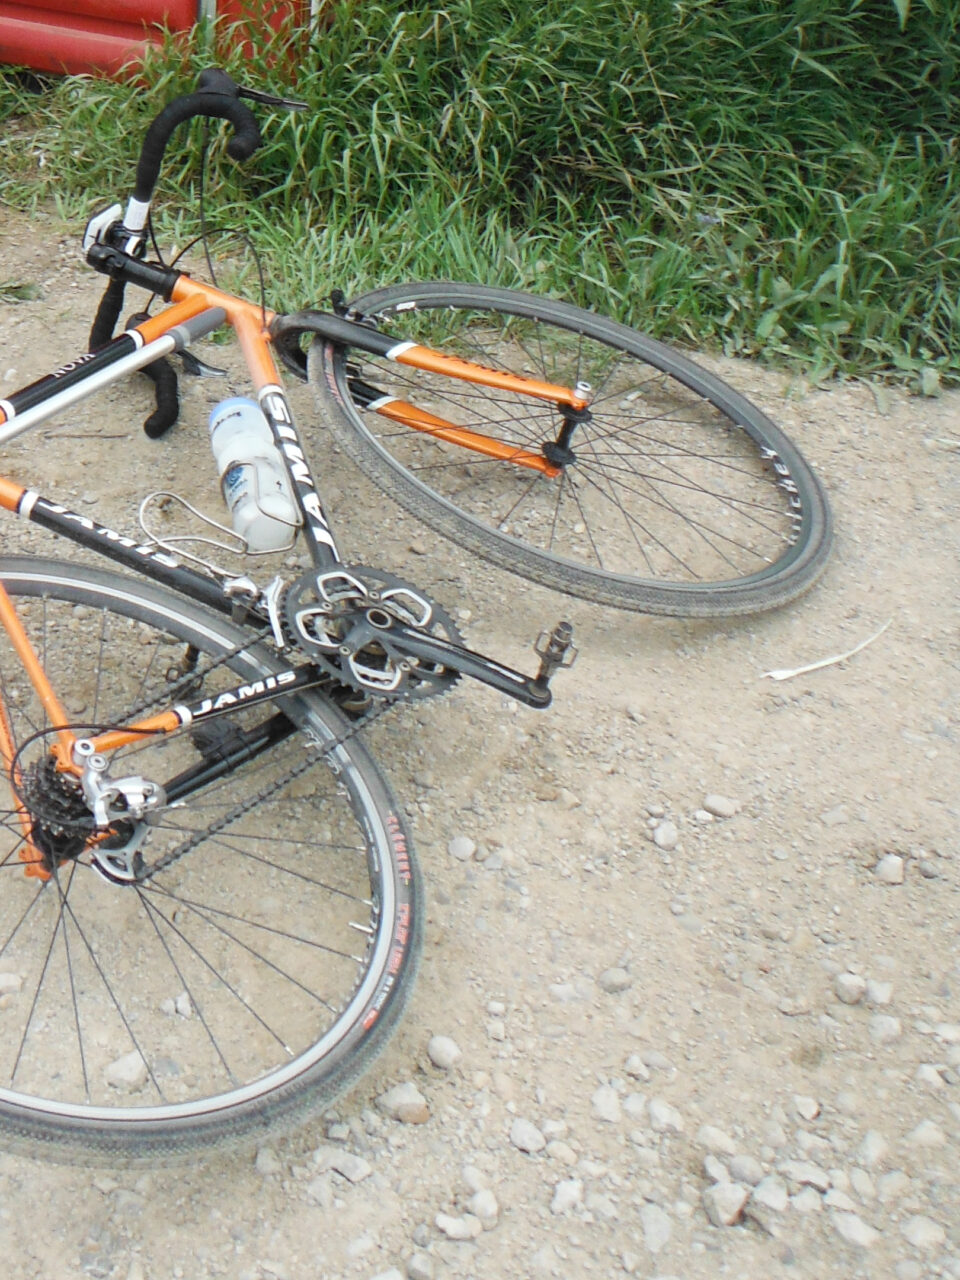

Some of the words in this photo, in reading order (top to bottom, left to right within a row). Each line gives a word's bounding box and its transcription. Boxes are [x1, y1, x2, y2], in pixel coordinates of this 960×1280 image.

[54, 353, 96, 379] NOVA
[266, 395, 340, 563] JAMIS
[38, 501, 178, 568] JAMIS
[193, 670, 297, 717] JAMIS
